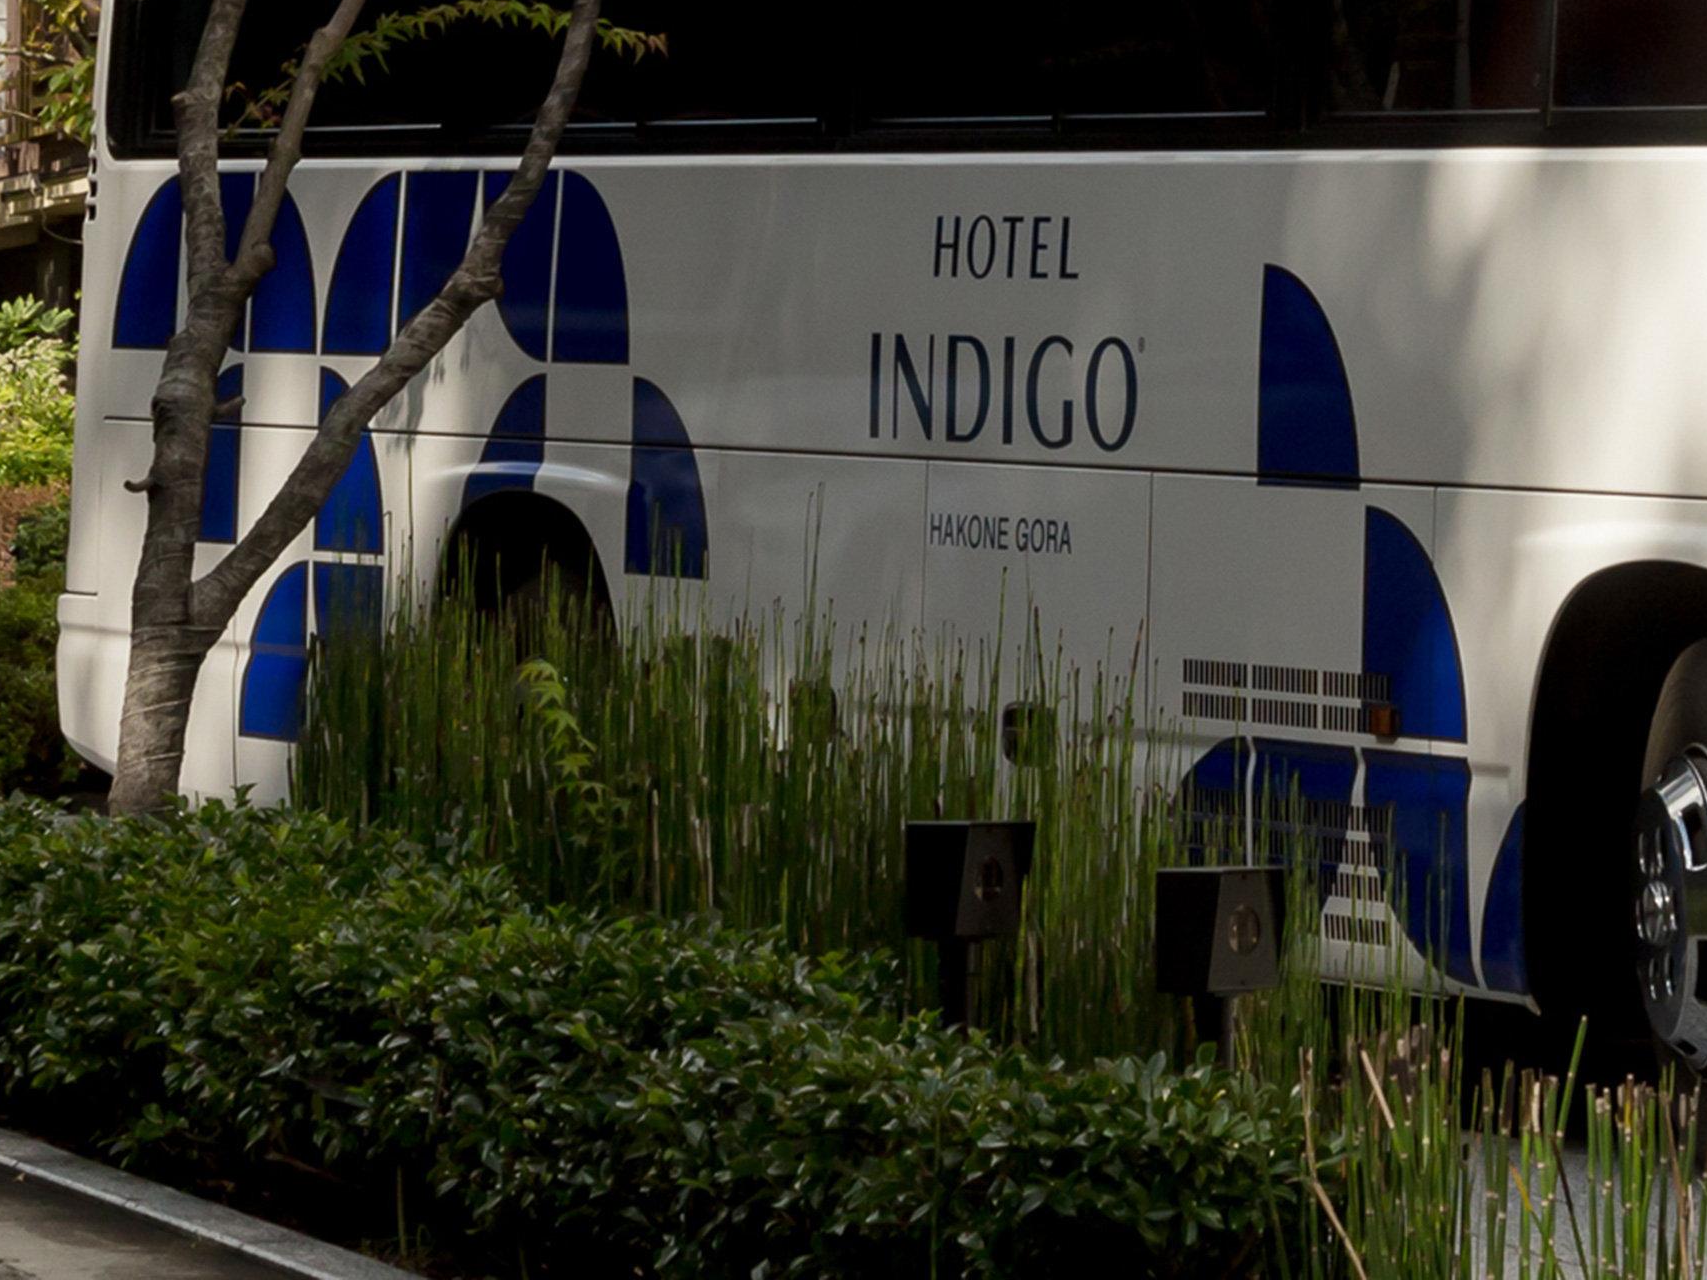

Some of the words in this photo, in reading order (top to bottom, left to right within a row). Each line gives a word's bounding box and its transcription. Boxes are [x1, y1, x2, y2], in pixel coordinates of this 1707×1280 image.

[933, 215, 1079, 279] HOTEL
[869, 332, 1139, 452] INDIGO
[930, 513, 1010, 550] HAKONE
[1015, 517, 1072, 554] GORA
